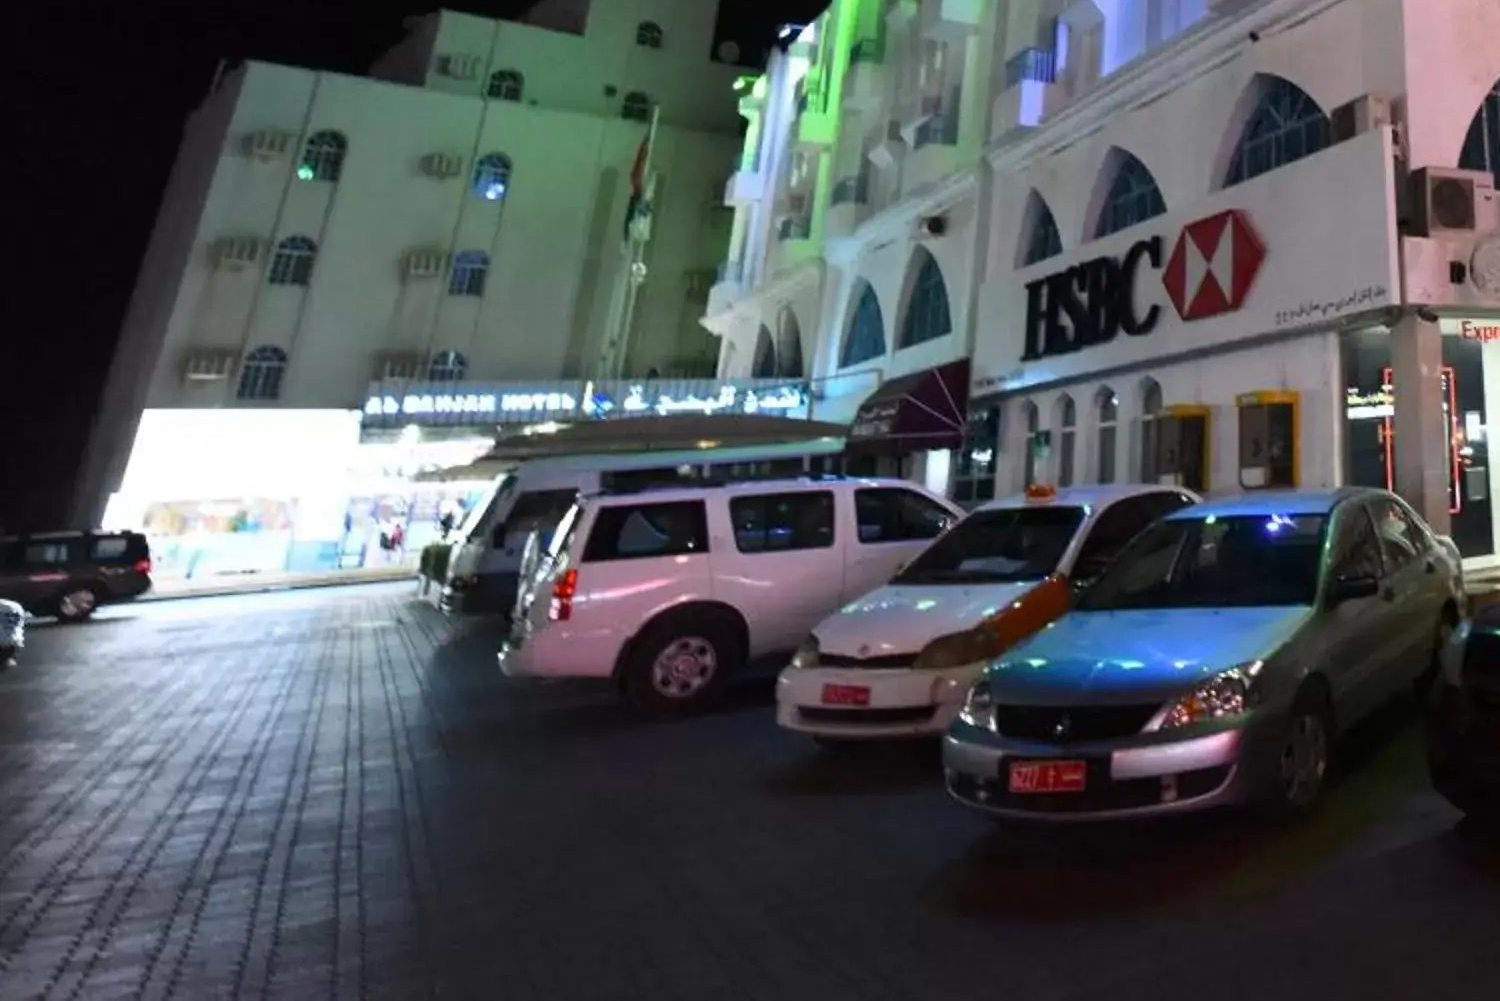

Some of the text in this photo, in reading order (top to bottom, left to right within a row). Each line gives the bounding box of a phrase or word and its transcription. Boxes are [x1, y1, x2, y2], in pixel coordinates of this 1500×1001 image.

[1019, 235, 1163, 363] HSBC
[365, 396, 399, 414] AL
[501, 392, 575, 411] HOTEL
